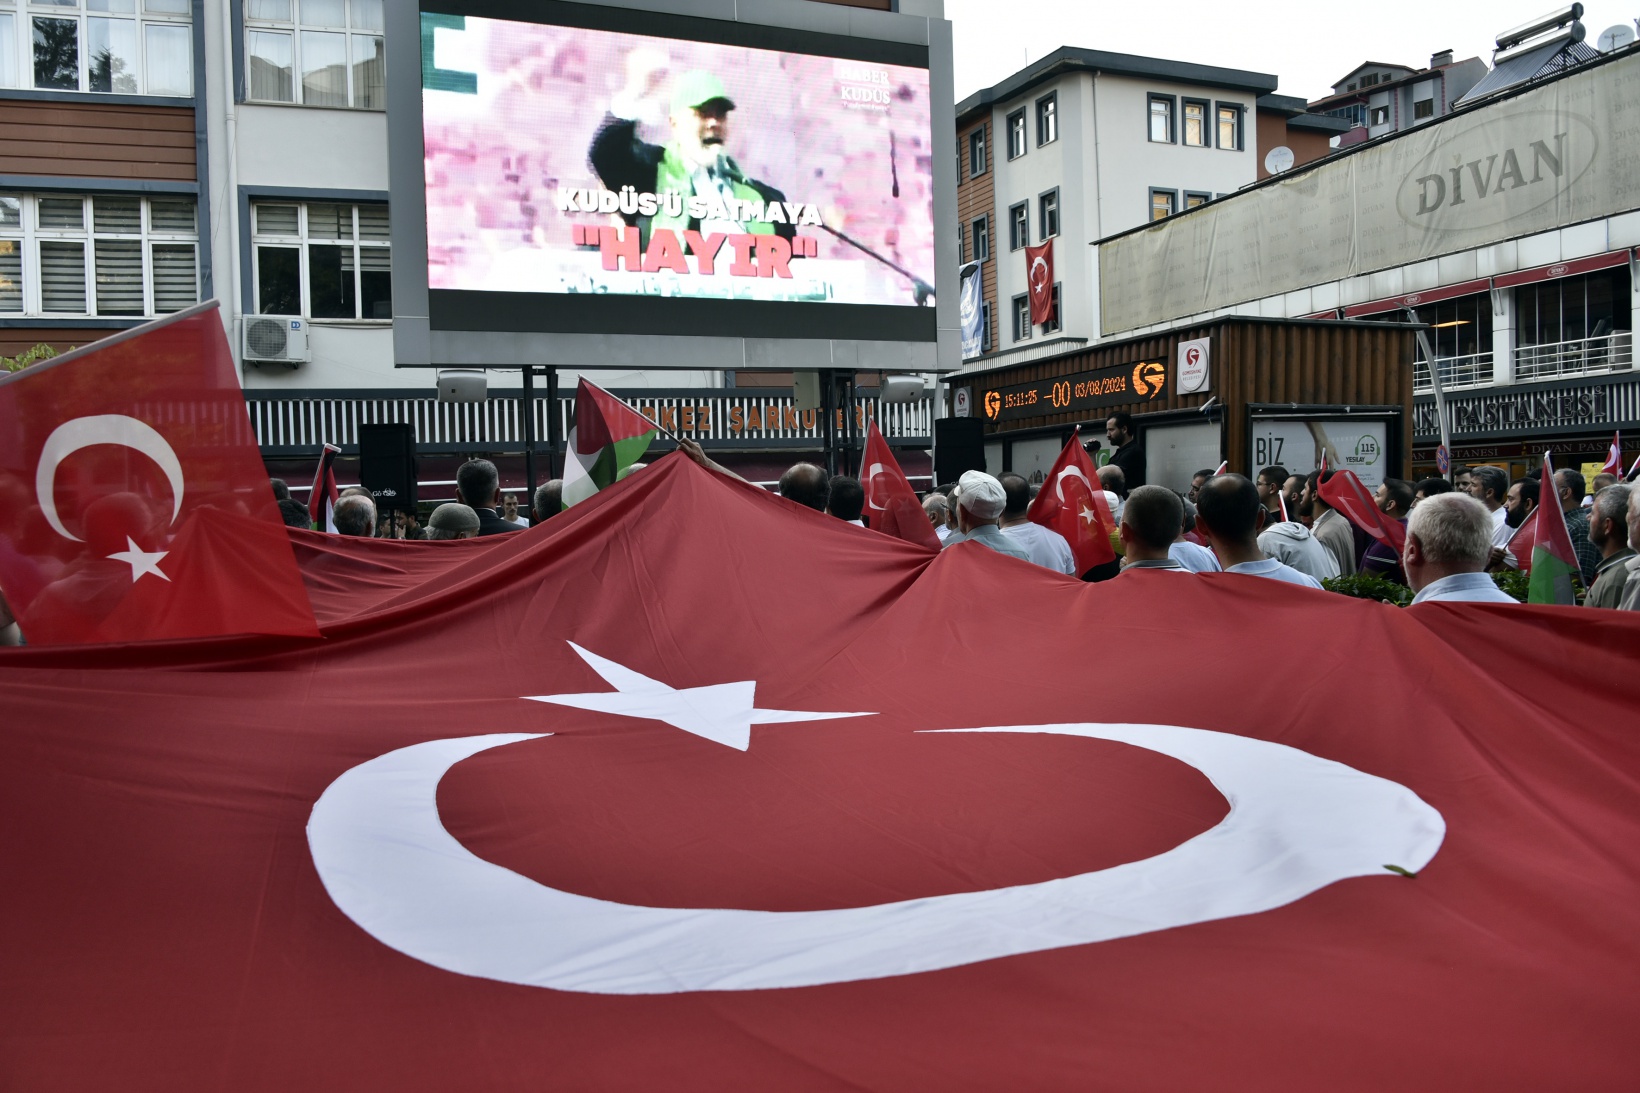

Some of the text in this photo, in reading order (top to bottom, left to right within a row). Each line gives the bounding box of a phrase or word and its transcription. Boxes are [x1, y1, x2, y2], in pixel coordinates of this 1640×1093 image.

[558, 185, 823, 226] KUDÜS'Ü SATMAYA
[1005, 390, 1037, 408] 15:11:25
[1075, 376, 1126, 398] 03/08/2024
[1455, 386, 1606, 428] PASTANESİ
[1256, 432, 1284, 466] BİZ
[1361, 443, 1375, 452] 115
